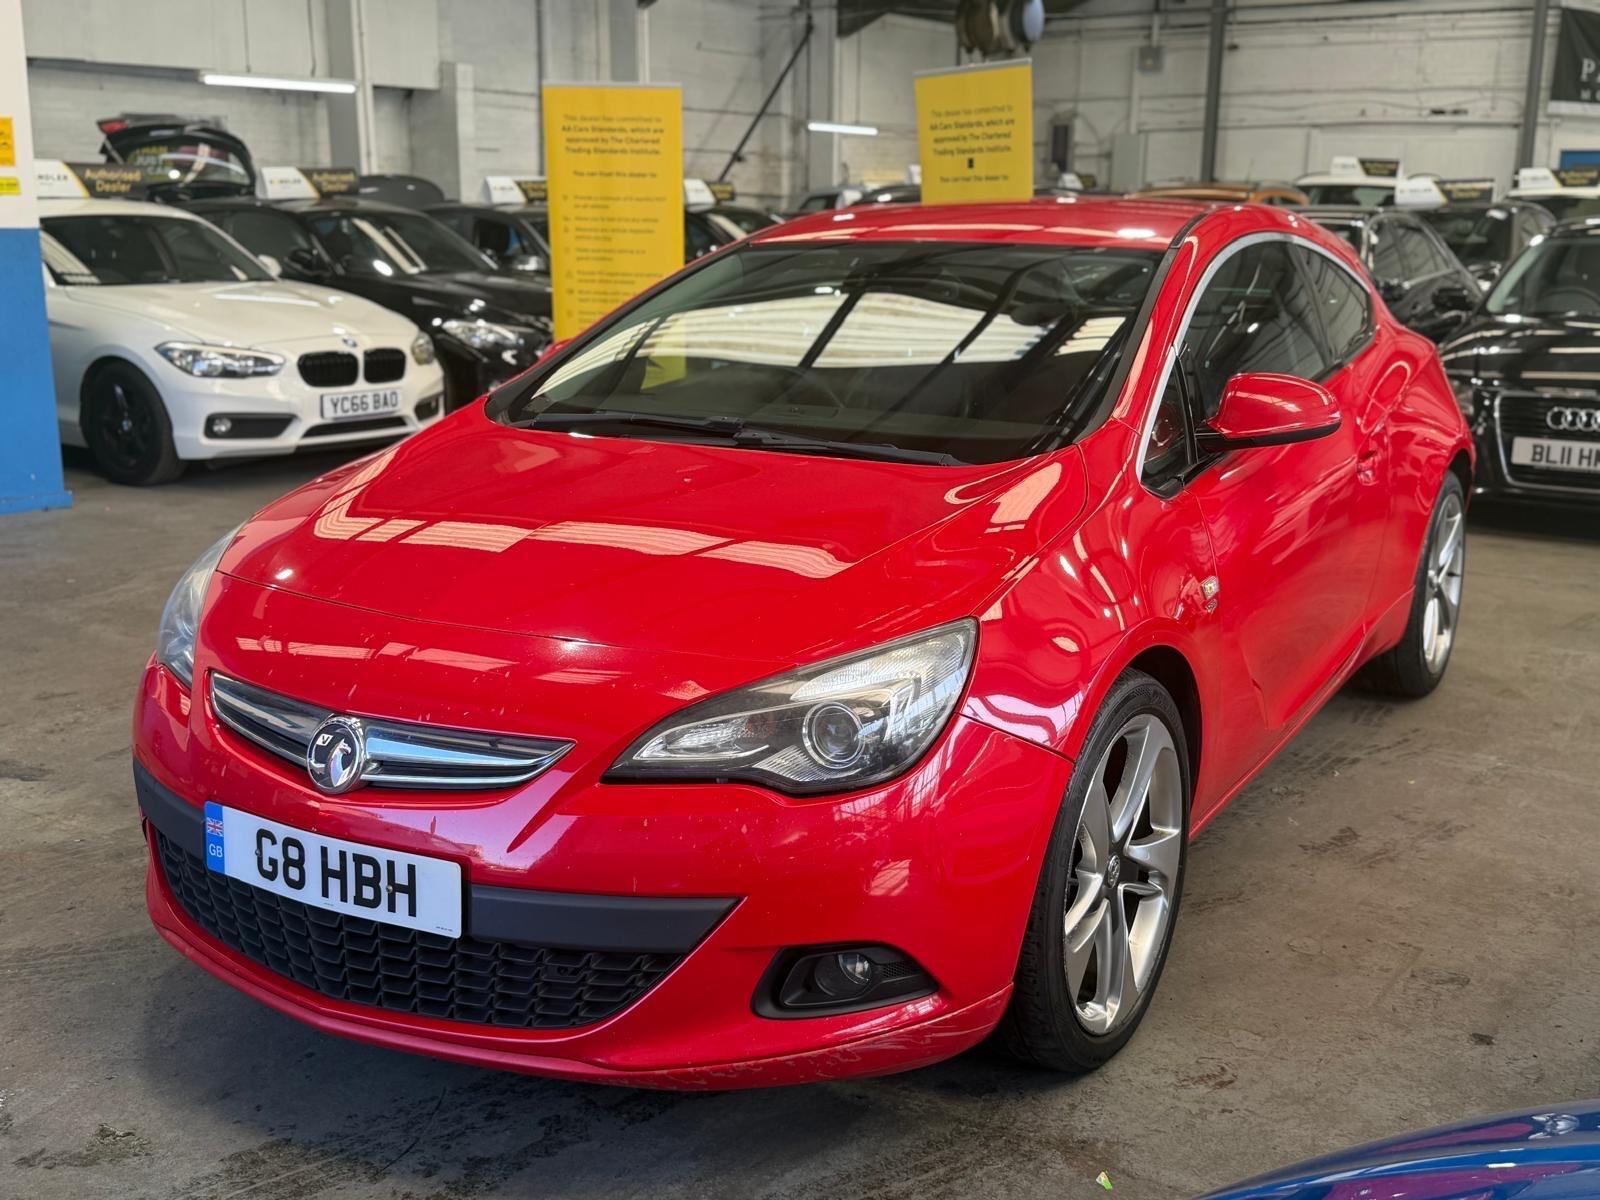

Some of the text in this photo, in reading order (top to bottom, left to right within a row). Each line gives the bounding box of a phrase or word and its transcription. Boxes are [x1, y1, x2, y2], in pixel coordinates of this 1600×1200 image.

[1580, 57, 1600, 83] P
[630, 126, 651, 134] which
[610, 136, 624, 144] The
[624, 136, 661, 145] Chartered
[84, 167, 142, 181] Authorised
[95, 180, 132, 192] Dealer
[330, 394, 369, 413] YC66
[1531, 443, 1572, 465] BL11
[209, 843, 223, 858] GB
[256, 827, 417, 918] G8 HBH
